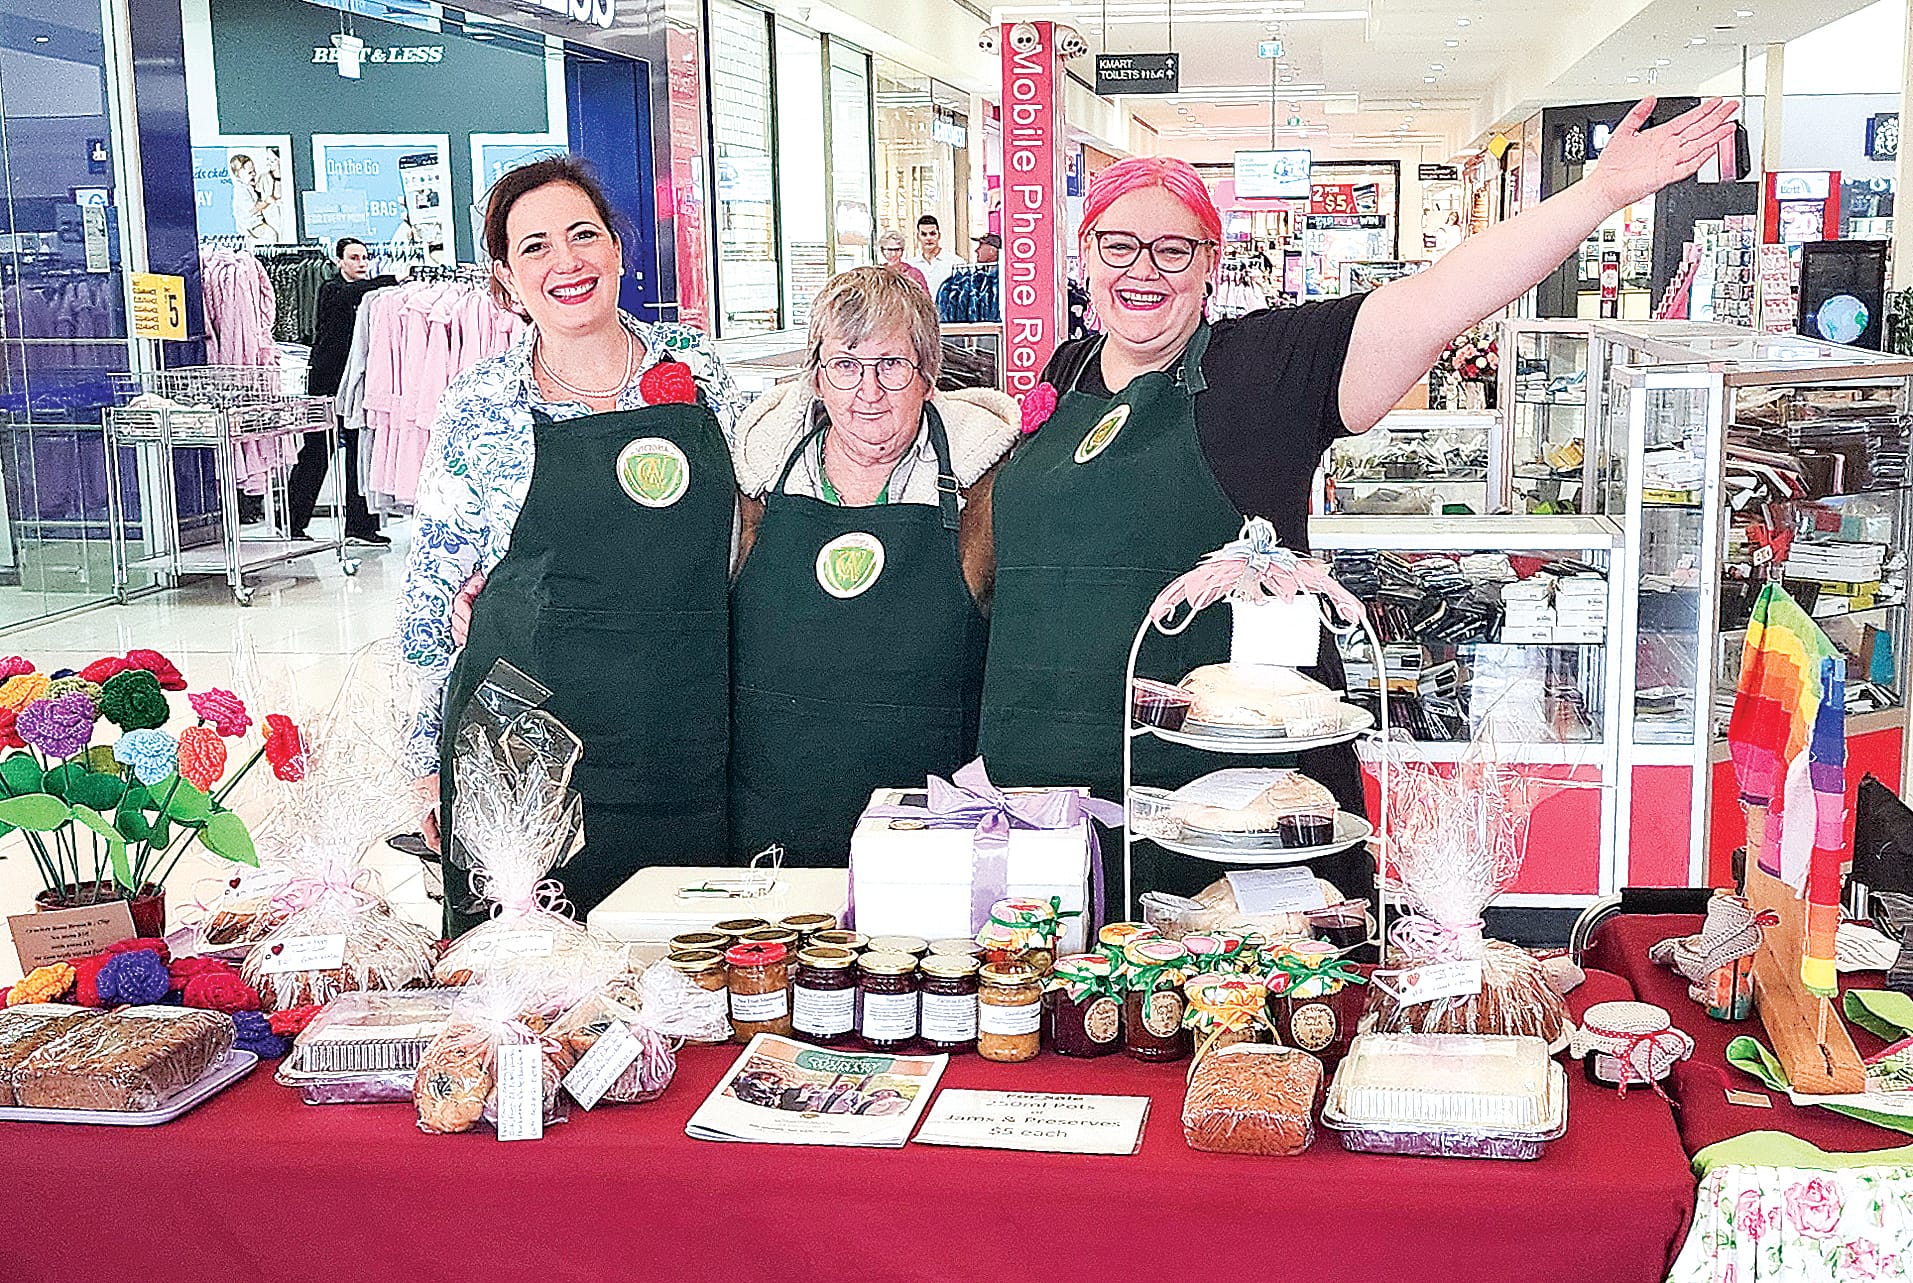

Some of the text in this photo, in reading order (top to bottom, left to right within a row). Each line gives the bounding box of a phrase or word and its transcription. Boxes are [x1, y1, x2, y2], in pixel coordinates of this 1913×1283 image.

[311, 46, 371, 63] BET
[386, 45, 444, 63] LESS
[1099, 58, 1133, 70] KMART
[1099, 69, 1140, 80] TOILETS
[1011, 38, 1044, 171] Mobile
[327, 158, 380, 176] On the Go
[1313, 186, 1324, 202] 2
[369, 200, 398, 217] BAG
[1325, 193, 1347, 213] $5
[1011, 184, 1044, 306] Phone
[168, 294, 179, 328] 5
[1054, 1102, 1096, 1111] Pots
[945, 1114, 1121, 1129] Jams & Preserves
[988, 1126, 1067, 1139] $5 each
